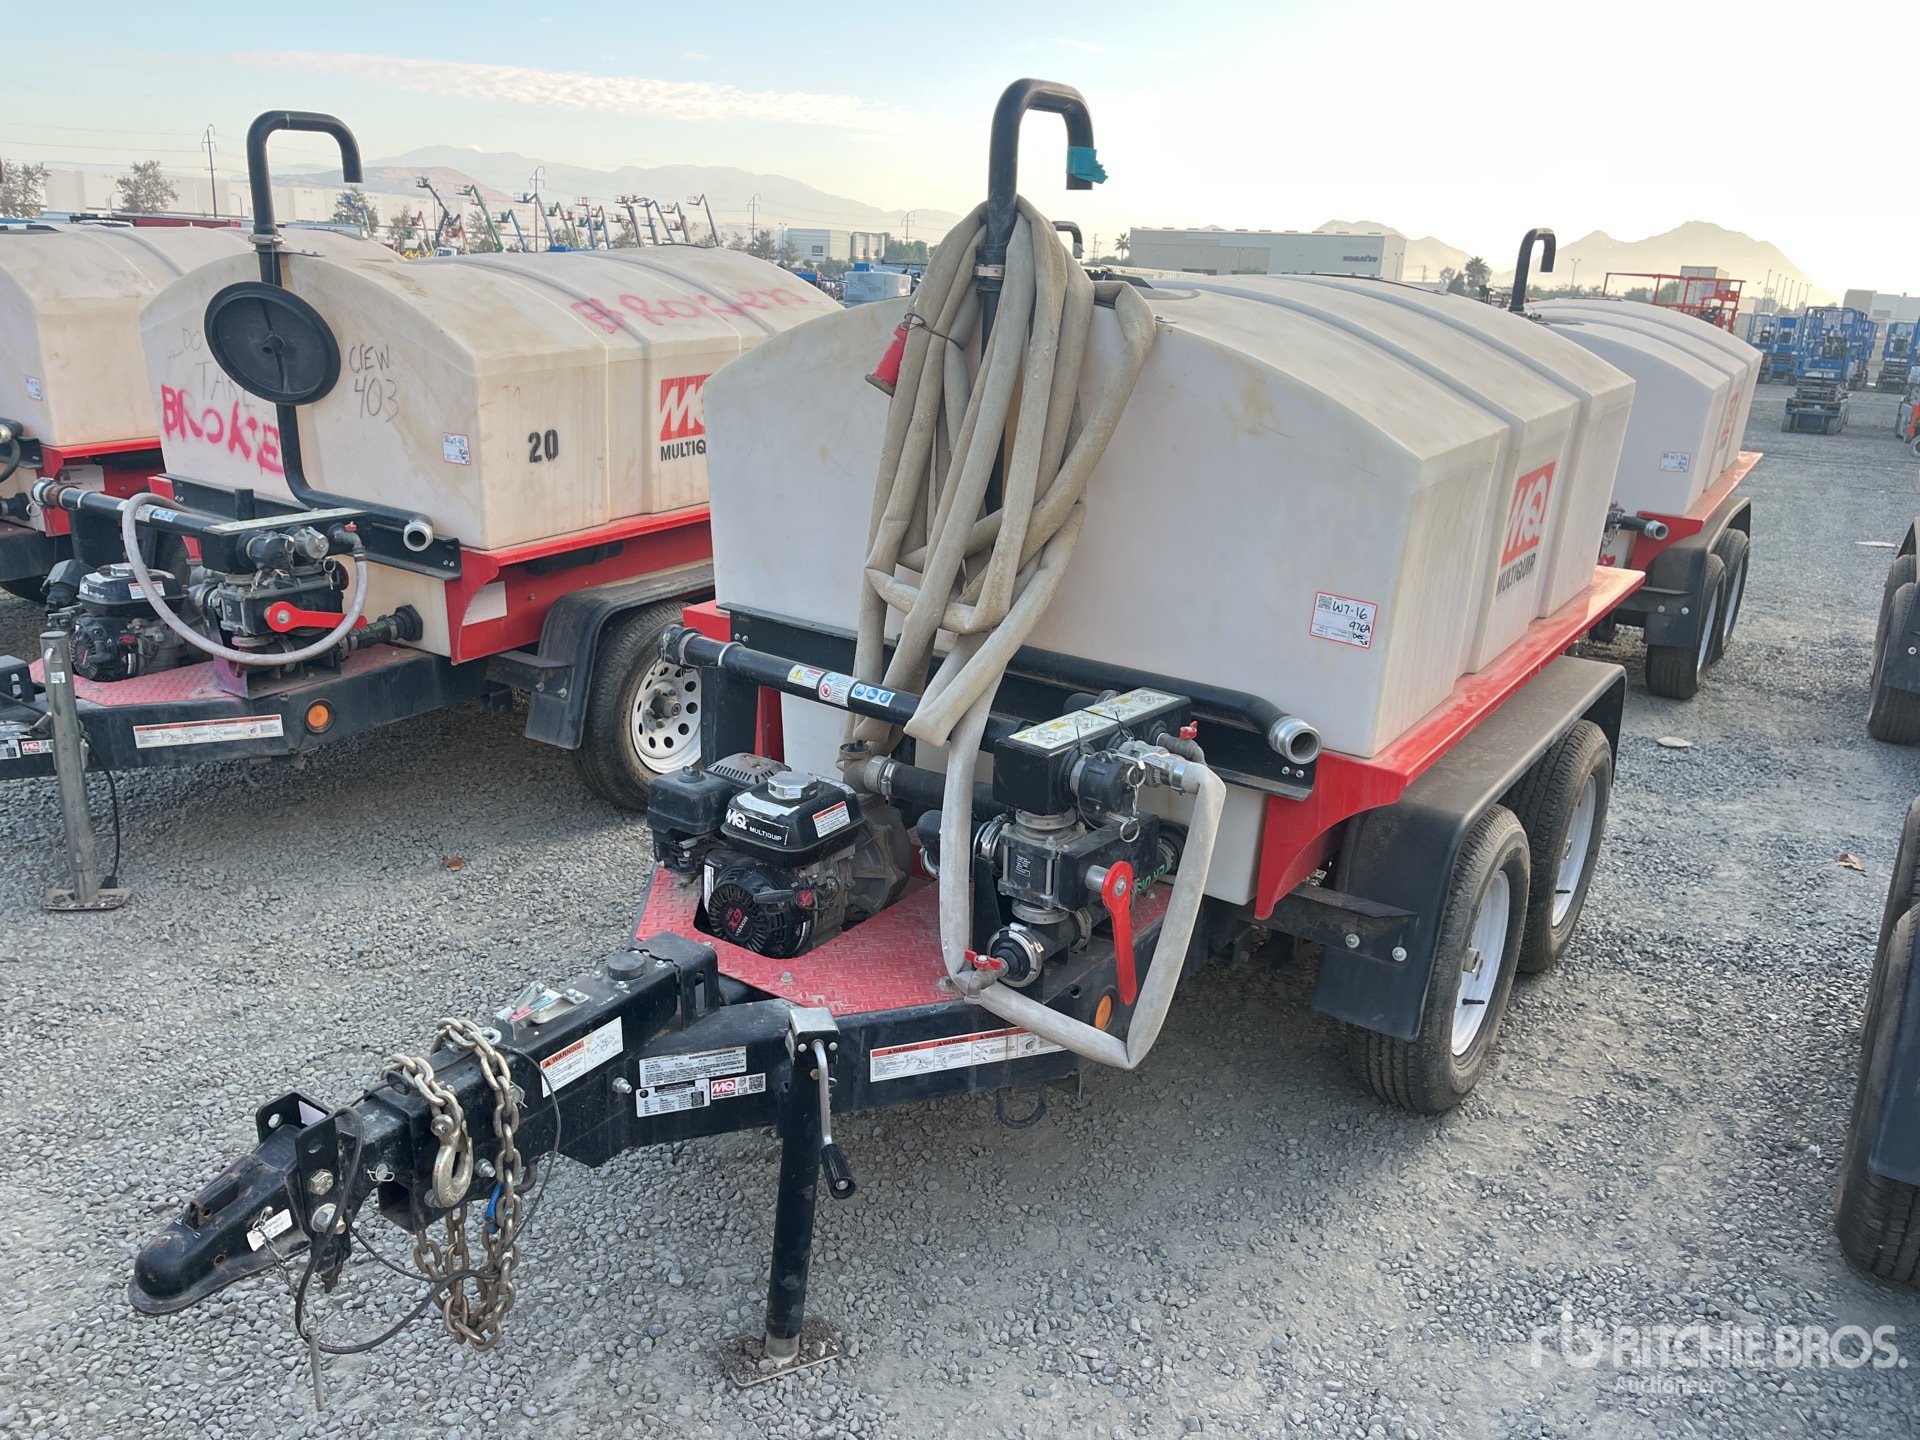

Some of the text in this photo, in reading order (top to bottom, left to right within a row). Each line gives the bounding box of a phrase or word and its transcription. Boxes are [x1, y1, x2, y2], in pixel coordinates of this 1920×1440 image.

[354, 375, 400, 422] 403
[528, 428, 559, 463] 20
[660, 439, 706, 461] MULTIQ
[1496, 552, 1536, 597] MULTIQUIP
[1332, 600, 1368, 620] W7-16
[725, 808, 782, 841] MQ MULTIQUIP
[553, 1042, 583, 1064] WARNING
[892, 1044, 920, 1055] WARNING
[942, 1037, 969, 1047] WARNING
[712, 1080, 736, 1093] MQ
